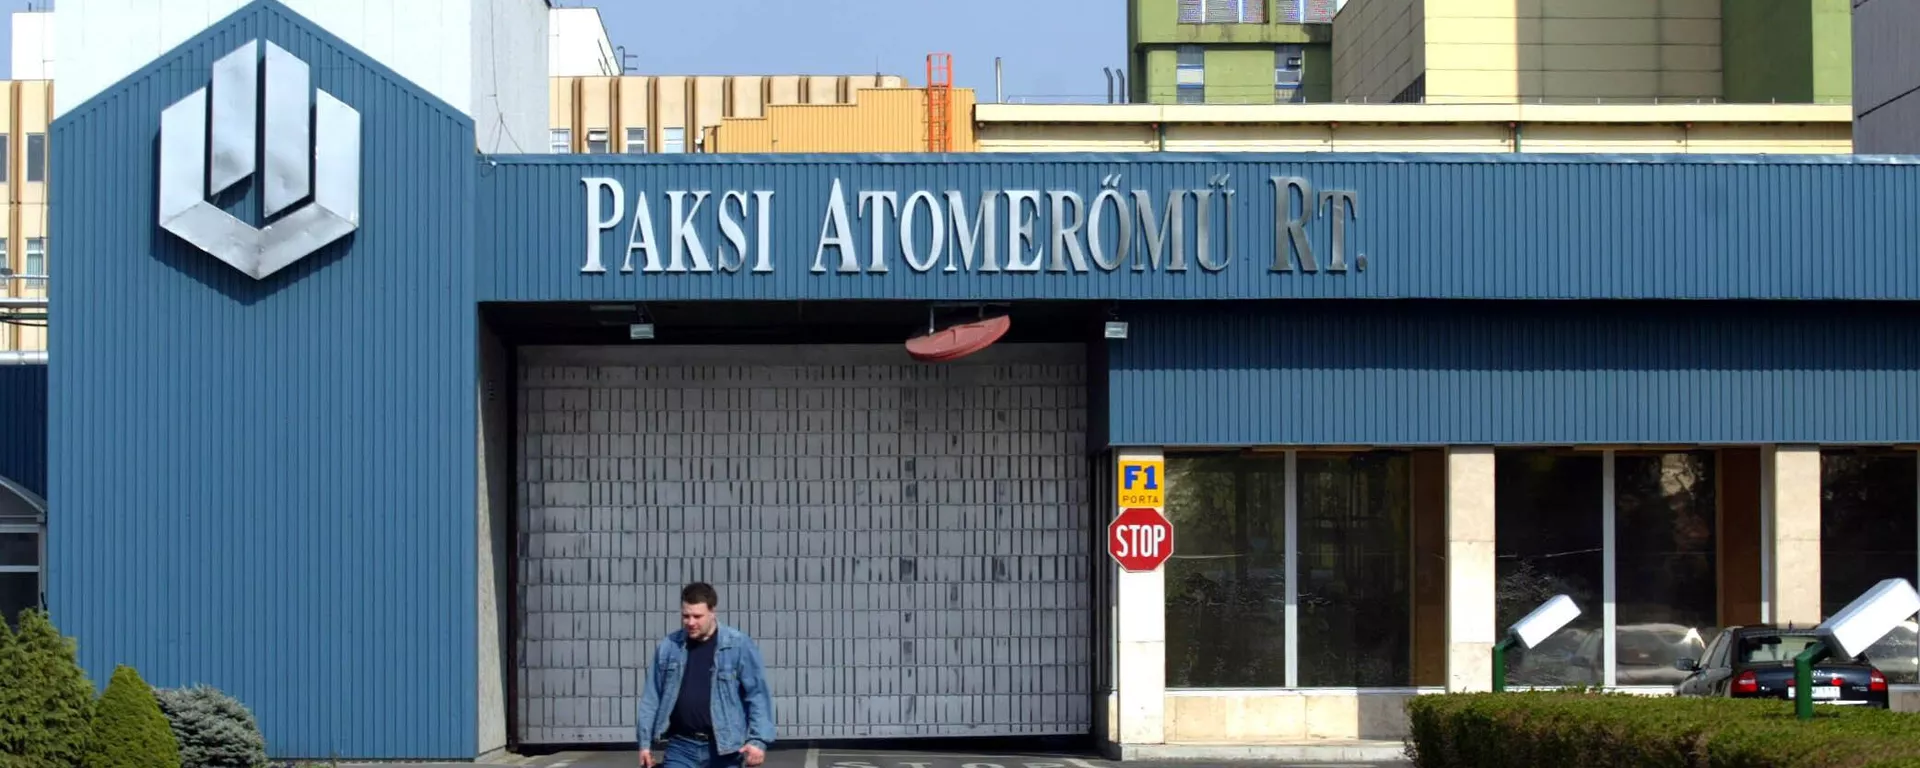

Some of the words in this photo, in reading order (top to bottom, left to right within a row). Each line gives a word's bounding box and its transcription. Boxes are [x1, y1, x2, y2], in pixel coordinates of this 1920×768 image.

[580, 176, 775, 273] PAKSI
[810, 173, 1236, 273] ATOMERŐMŰ
[1268, 175, 1369, 273] RT.
[1123, 465, 1158, 490] F1
[1122, 495, 1159, 504] PORTA
[1116, 524, 1166, 558] STOP
